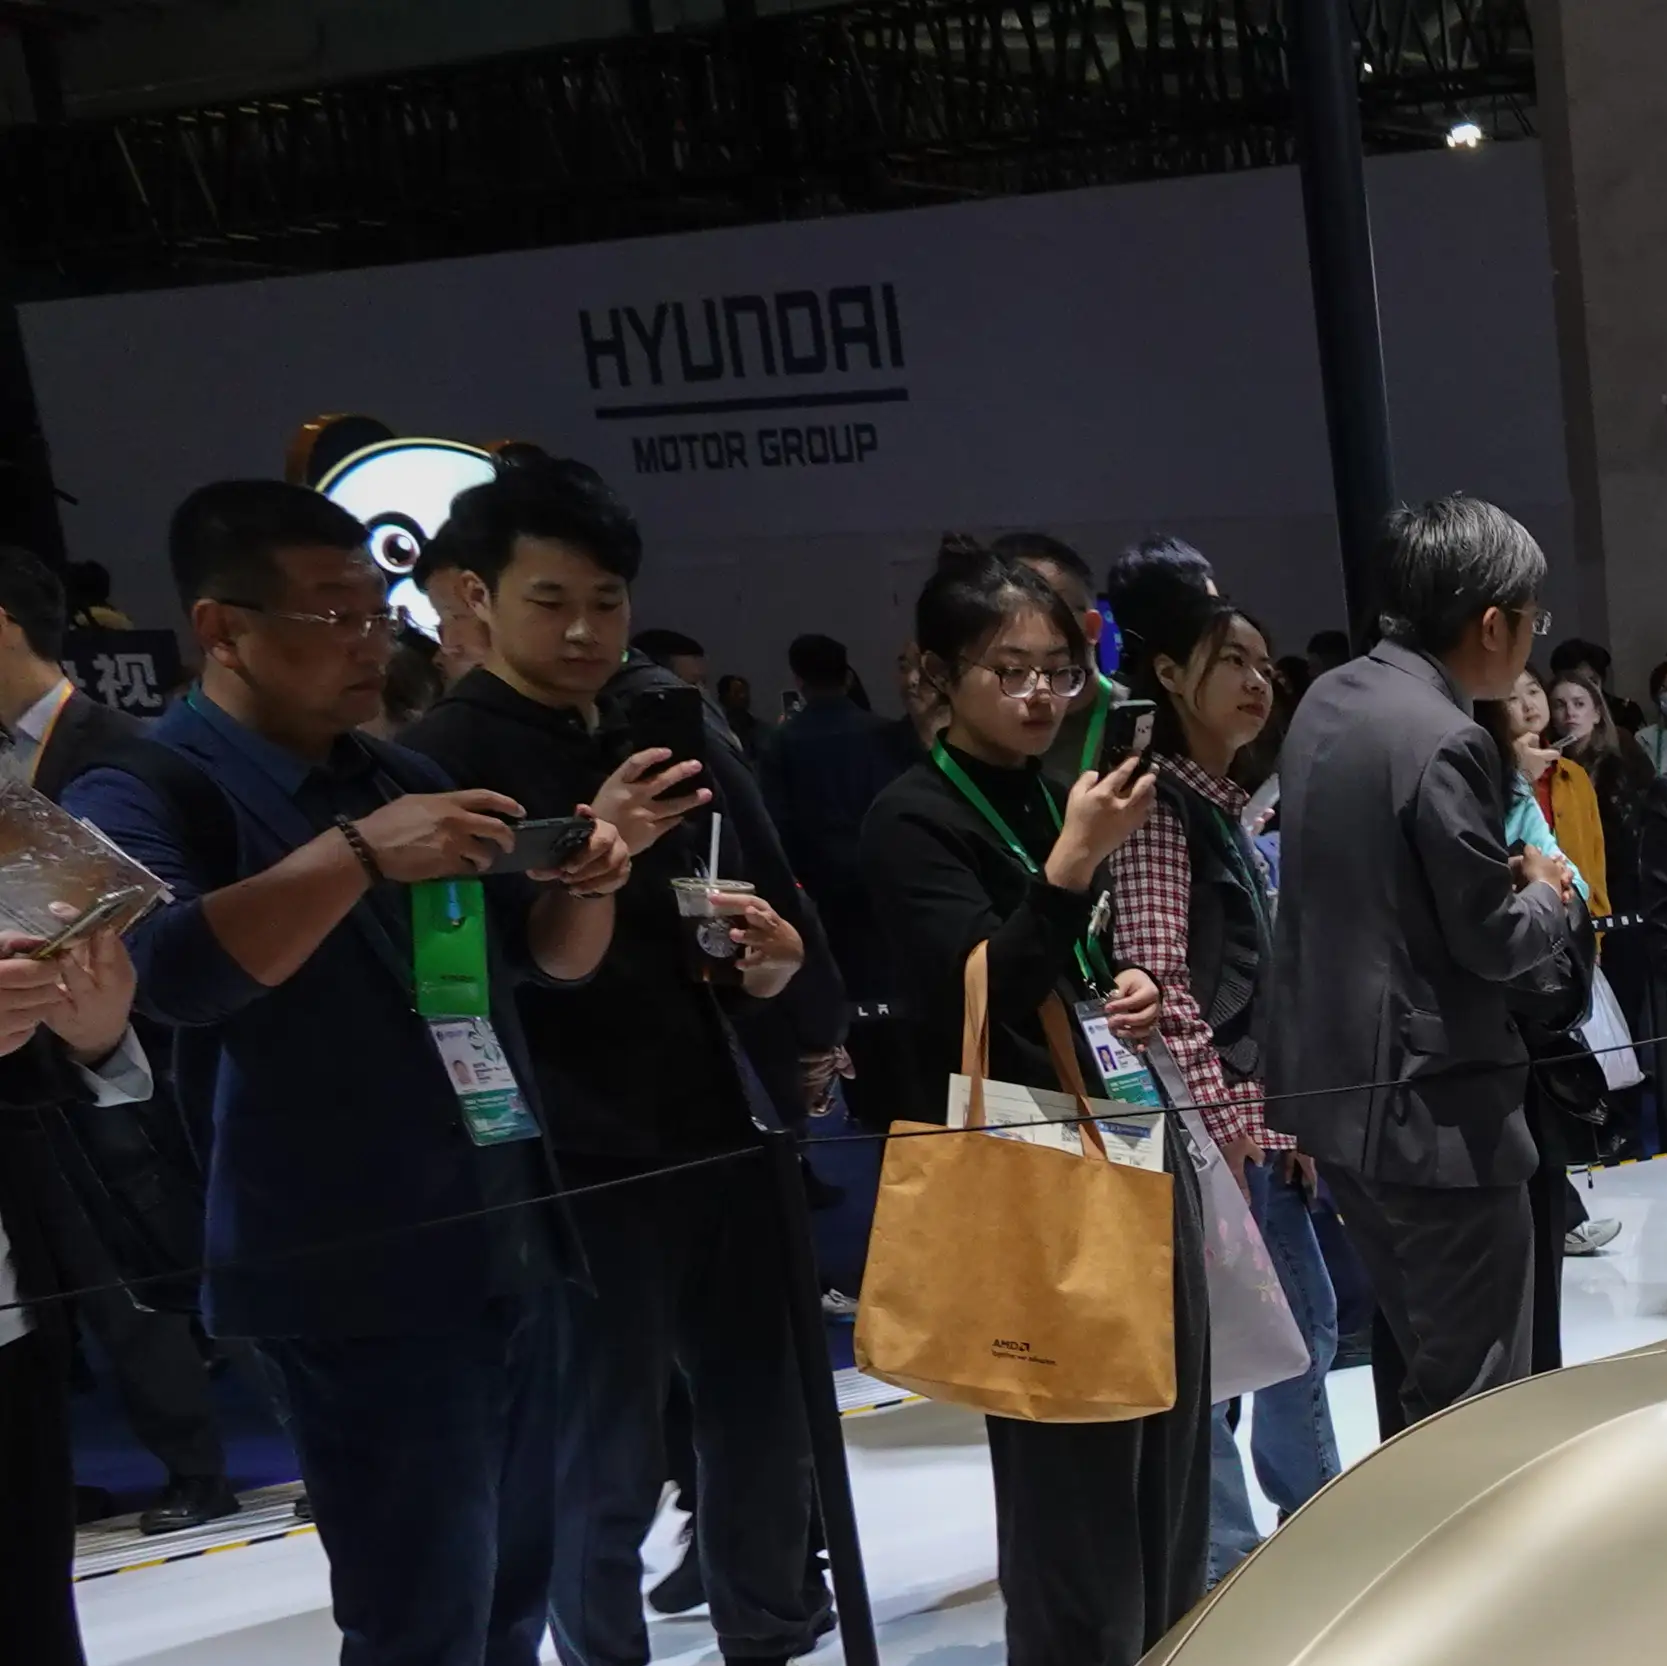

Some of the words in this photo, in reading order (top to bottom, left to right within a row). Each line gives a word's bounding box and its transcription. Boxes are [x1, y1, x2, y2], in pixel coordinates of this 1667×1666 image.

[578, 283, 905, 389] HYUNDAI
[632, 430, 749, 473] MOTOR
[756, 422, 878, 468] GROUP
[1591, 914, 1643, 929] TESL
[992, 1339, 1019, 1351] AMD
